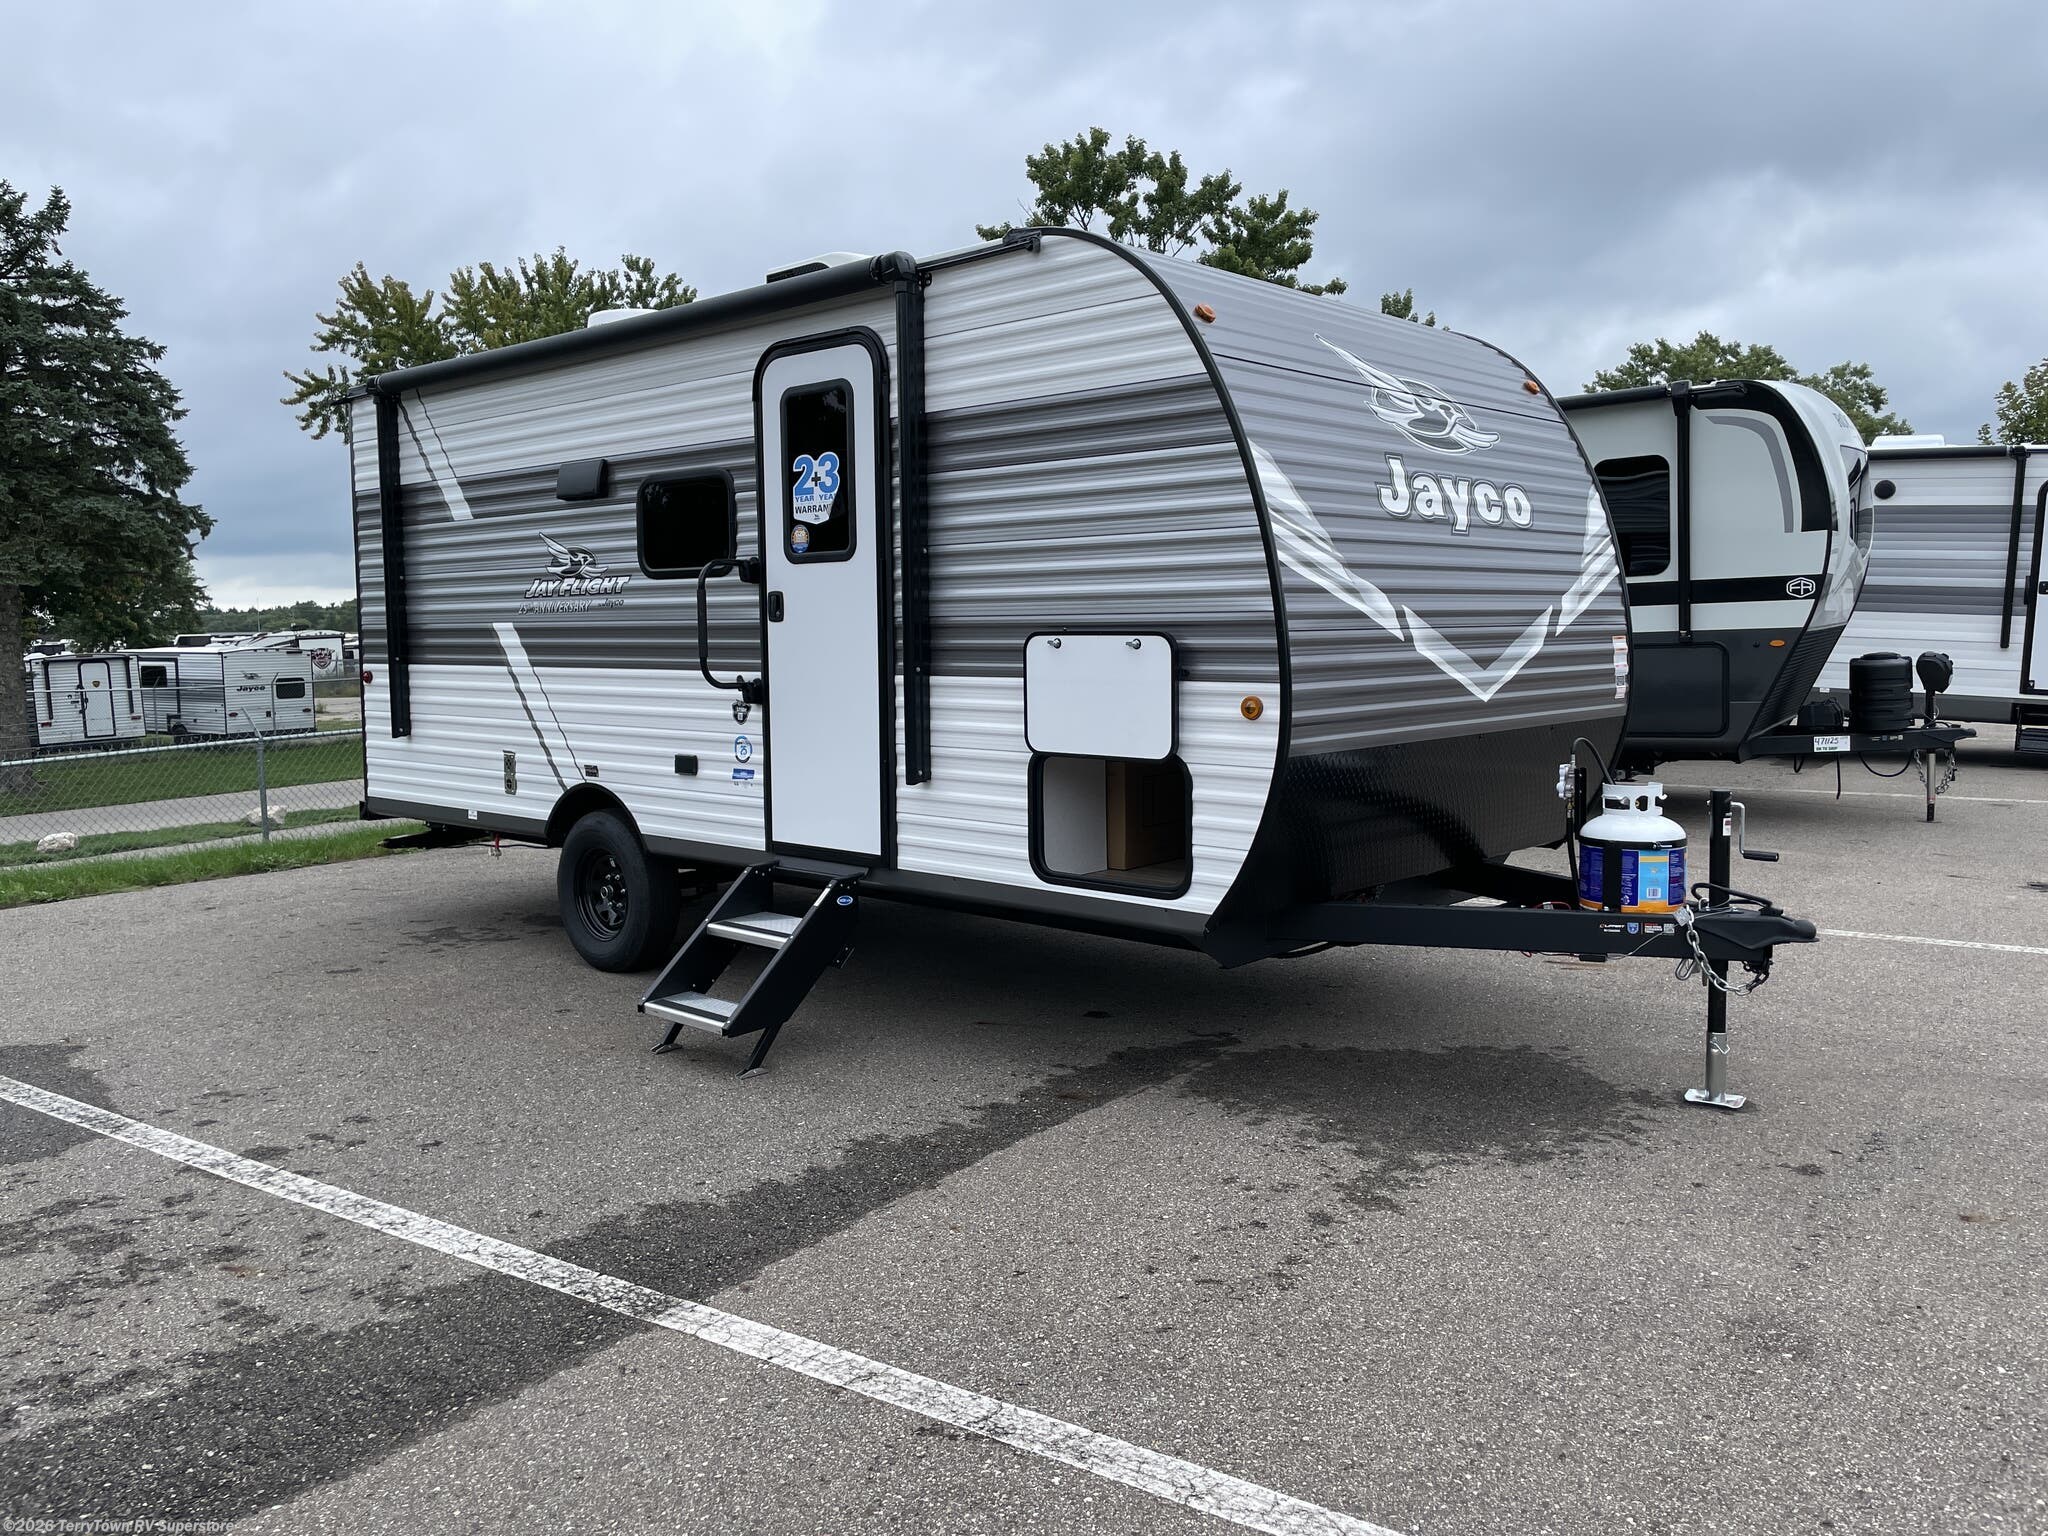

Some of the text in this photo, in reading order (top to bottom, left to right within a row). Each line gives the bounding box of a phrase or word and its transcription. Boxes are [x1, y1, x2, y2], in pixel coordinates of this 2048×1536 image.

[795, 493, 837, 503] YEAR YEA
[1375, 453, 1533, 535] Jayco
[524, 575, 632, 598] JAY FLIGHT
[534, 600, 592, 615] ANNIVERSARY
